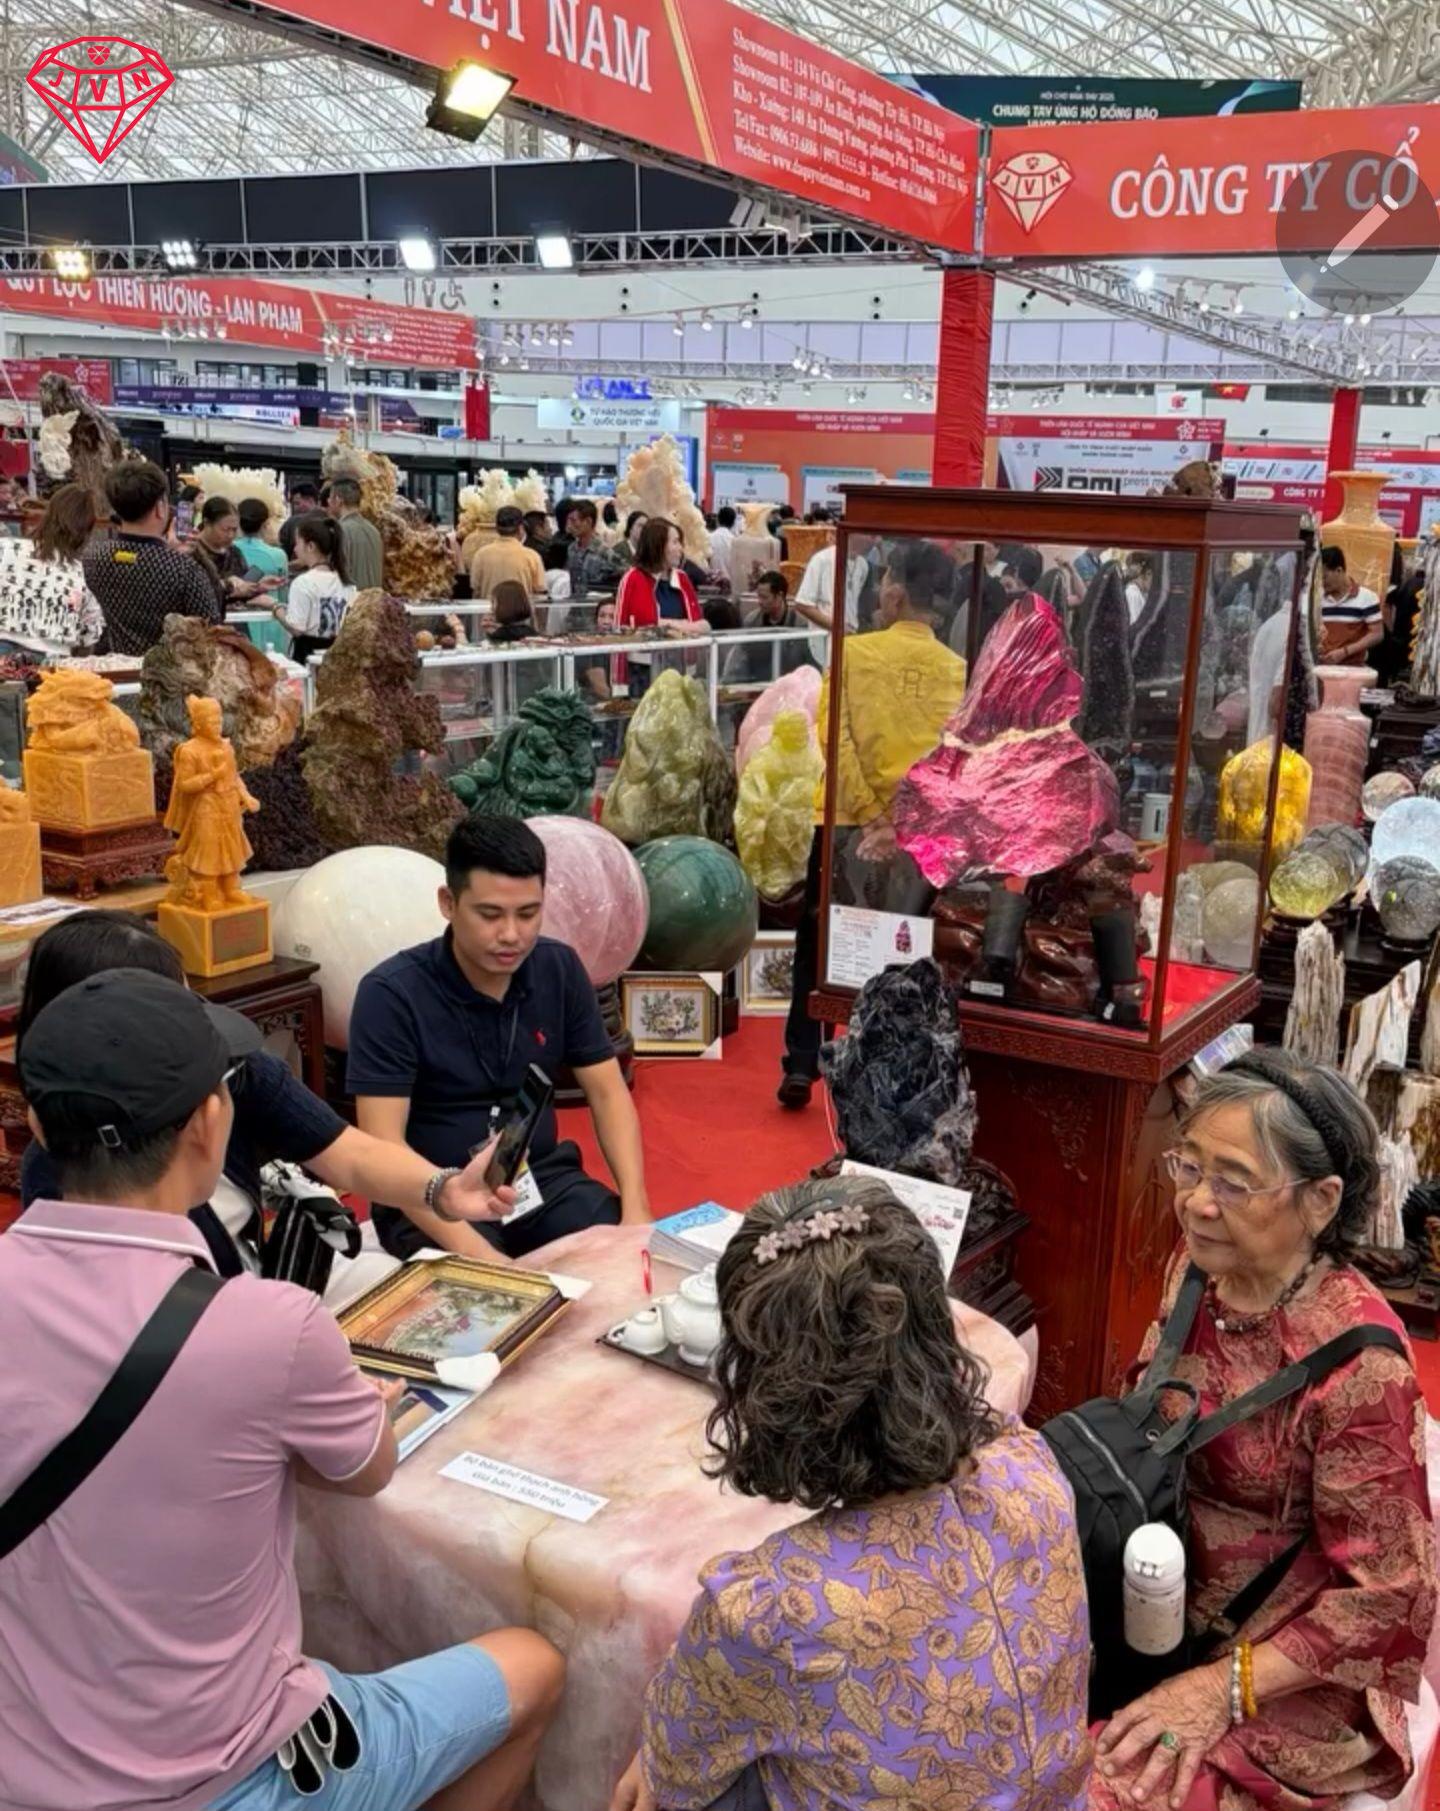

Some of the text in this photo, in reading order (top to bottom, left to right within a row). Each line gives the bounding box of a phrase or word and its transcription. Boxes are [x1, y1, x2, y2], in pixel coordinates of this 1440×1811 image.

[546, 0, 653, 94] NAM
[992, 104, 1031, 118] CHUNG
[1032, 105, 1053, 118] TAY
[1109, 154, 1249, 220] CÔNG
[1265, 160, 1332, 212] TY
[225, 294, 252, 327] LAN
